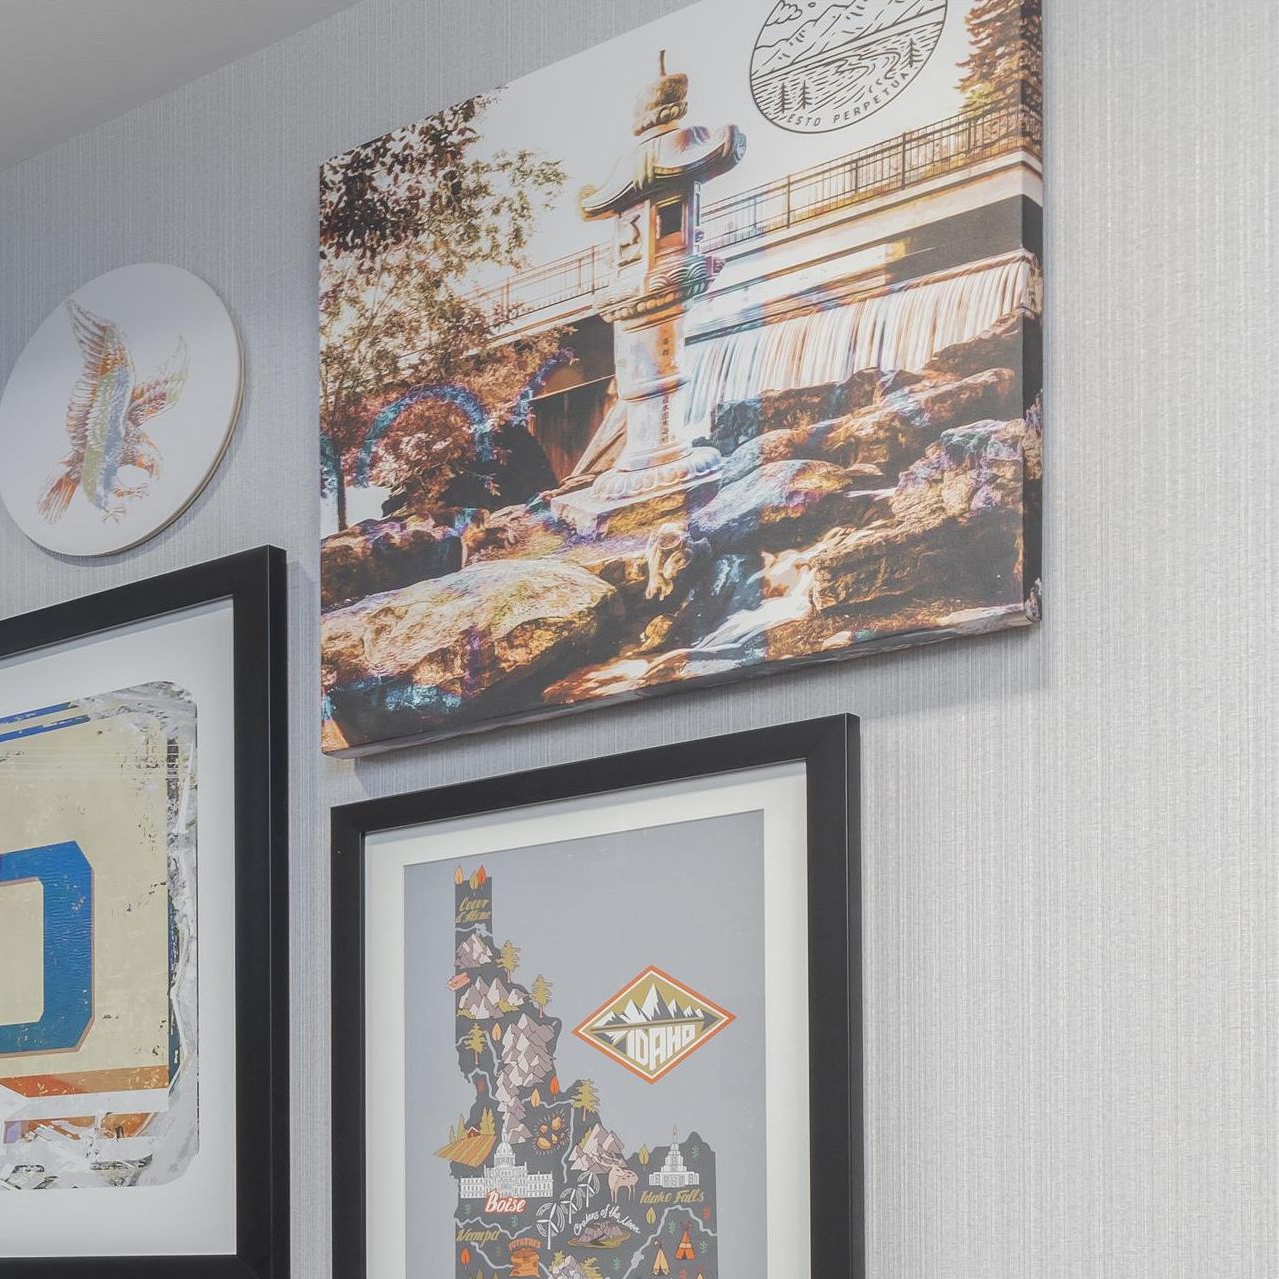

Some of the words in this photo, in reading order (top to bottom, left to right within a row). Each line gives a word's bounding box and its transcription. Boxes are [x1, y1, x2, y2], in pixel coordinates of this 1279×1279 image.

[787, 113, 822, 127] ESTO
[833, 72, 910, 124] PERPETUA
[627, 1024, 696, 1071] IDAHO
[485, 1189, 526, 1213] Boise
[673, 1188, 704, 1204] Falls
[600, 1203, 611, 1219] of
[608, 1205, 622, 1220] the
